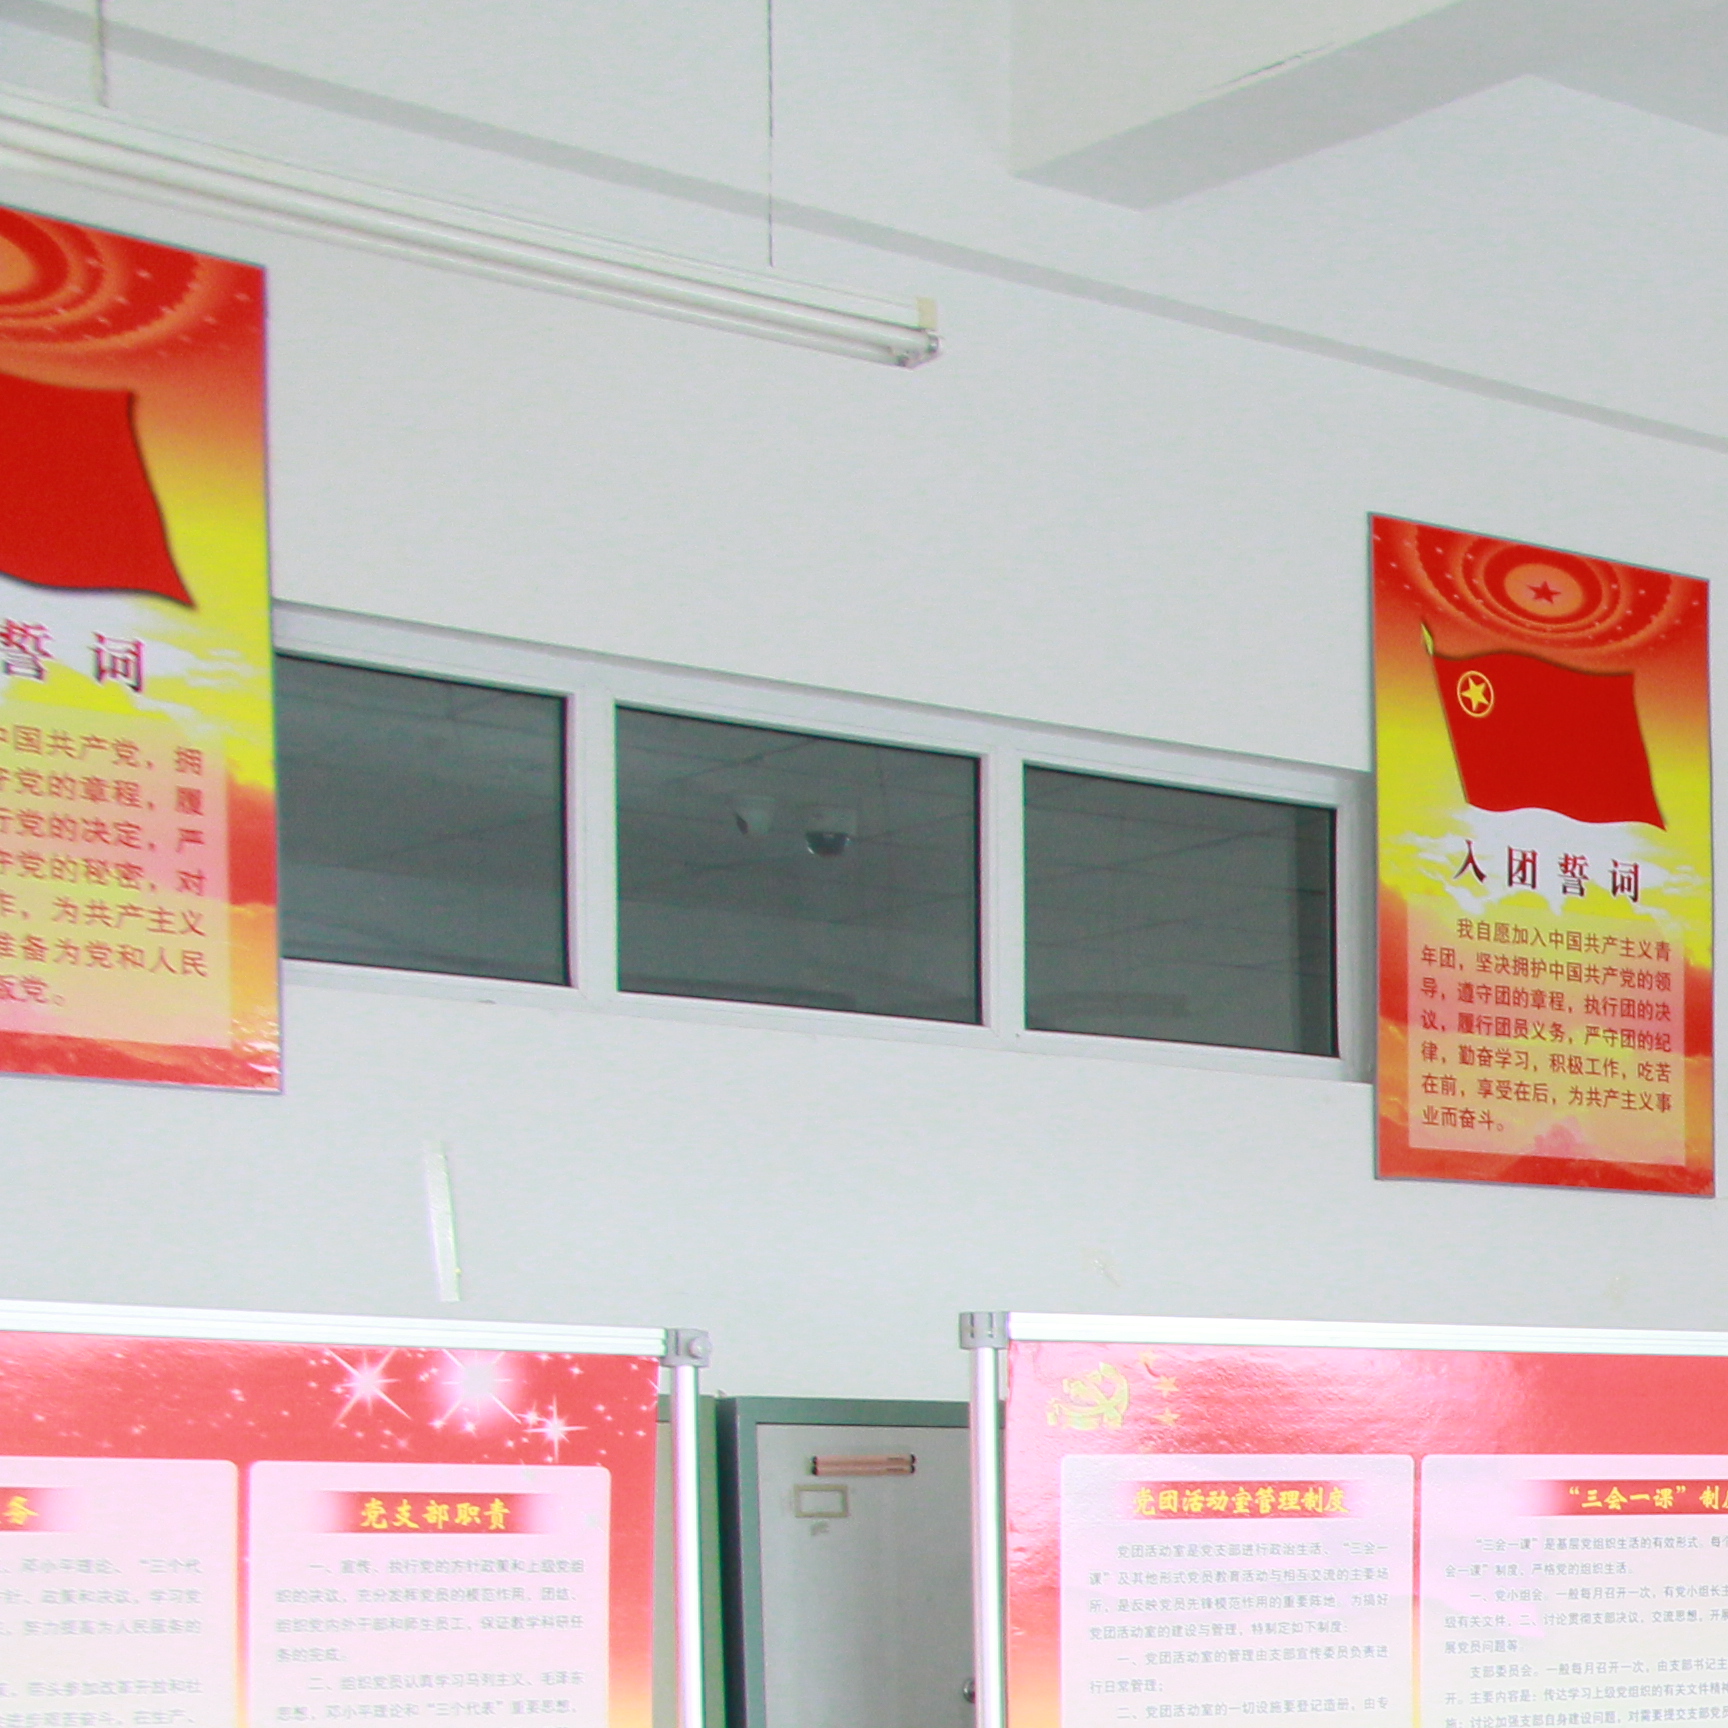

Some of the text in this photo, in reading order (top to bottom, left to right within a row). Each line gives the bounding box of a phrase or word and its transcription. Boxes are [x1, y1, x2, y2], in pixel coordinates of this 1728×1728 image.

[1453, 840, 1641, 903] 入团誓词
[1457, 918, 1671, 962] 我自愿加入中国共产主义青
[1421, 946, 1671, 992] 年团，坚决拥护中国共产党的领
[1420, 977, 1671, 1021] 导，遵守团的章程，执行团的决
[1420, 1010, 1671, 1053] 议，履行团员义务，严守团的纪
[1421, 1042, 1672, 1083] 律，勤奋学习，积极工作，吃苦
[1421, 1073, 1672, 1113] 在前，享受在后，为共产主义事
[1422, 1105, 1506, 1132] 业而奋斗。
[360, 1497, 511, 1532] 党支部职责
[1133, 1486, 1349, 1516] 党团活动室管理制度
